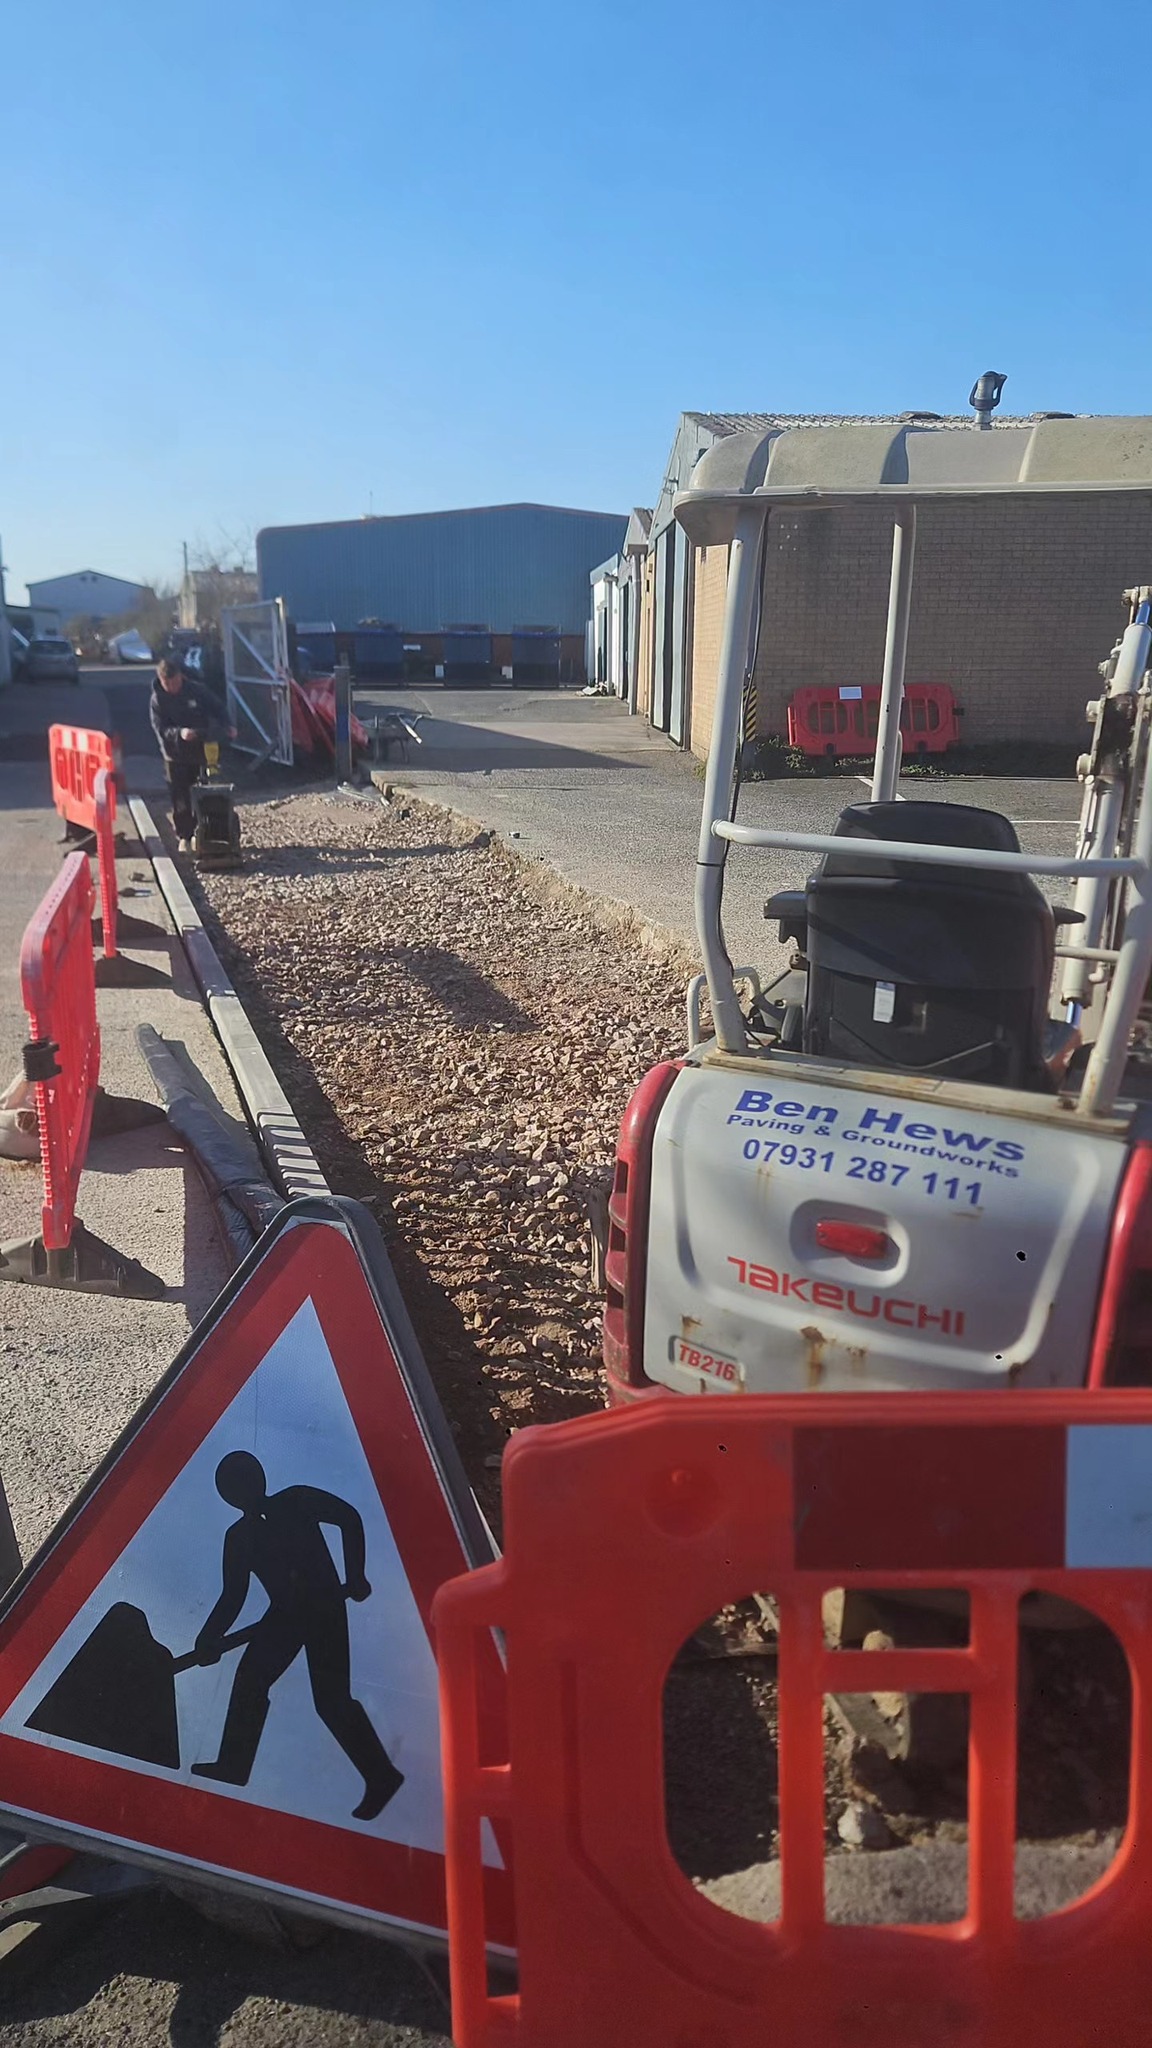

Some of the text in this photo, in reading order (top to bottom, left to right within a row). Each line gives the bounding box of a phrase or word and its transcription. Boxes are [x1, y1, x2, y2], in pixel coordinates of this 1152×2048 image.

[726, 1114, 1020, 1179] Paving & Groundworks
[734, 1089, 1025, 1161] Ben Hews
[742, 1138, 982, 1205] 07931 287 111
[679, 1343, 736, 1382] TB216
